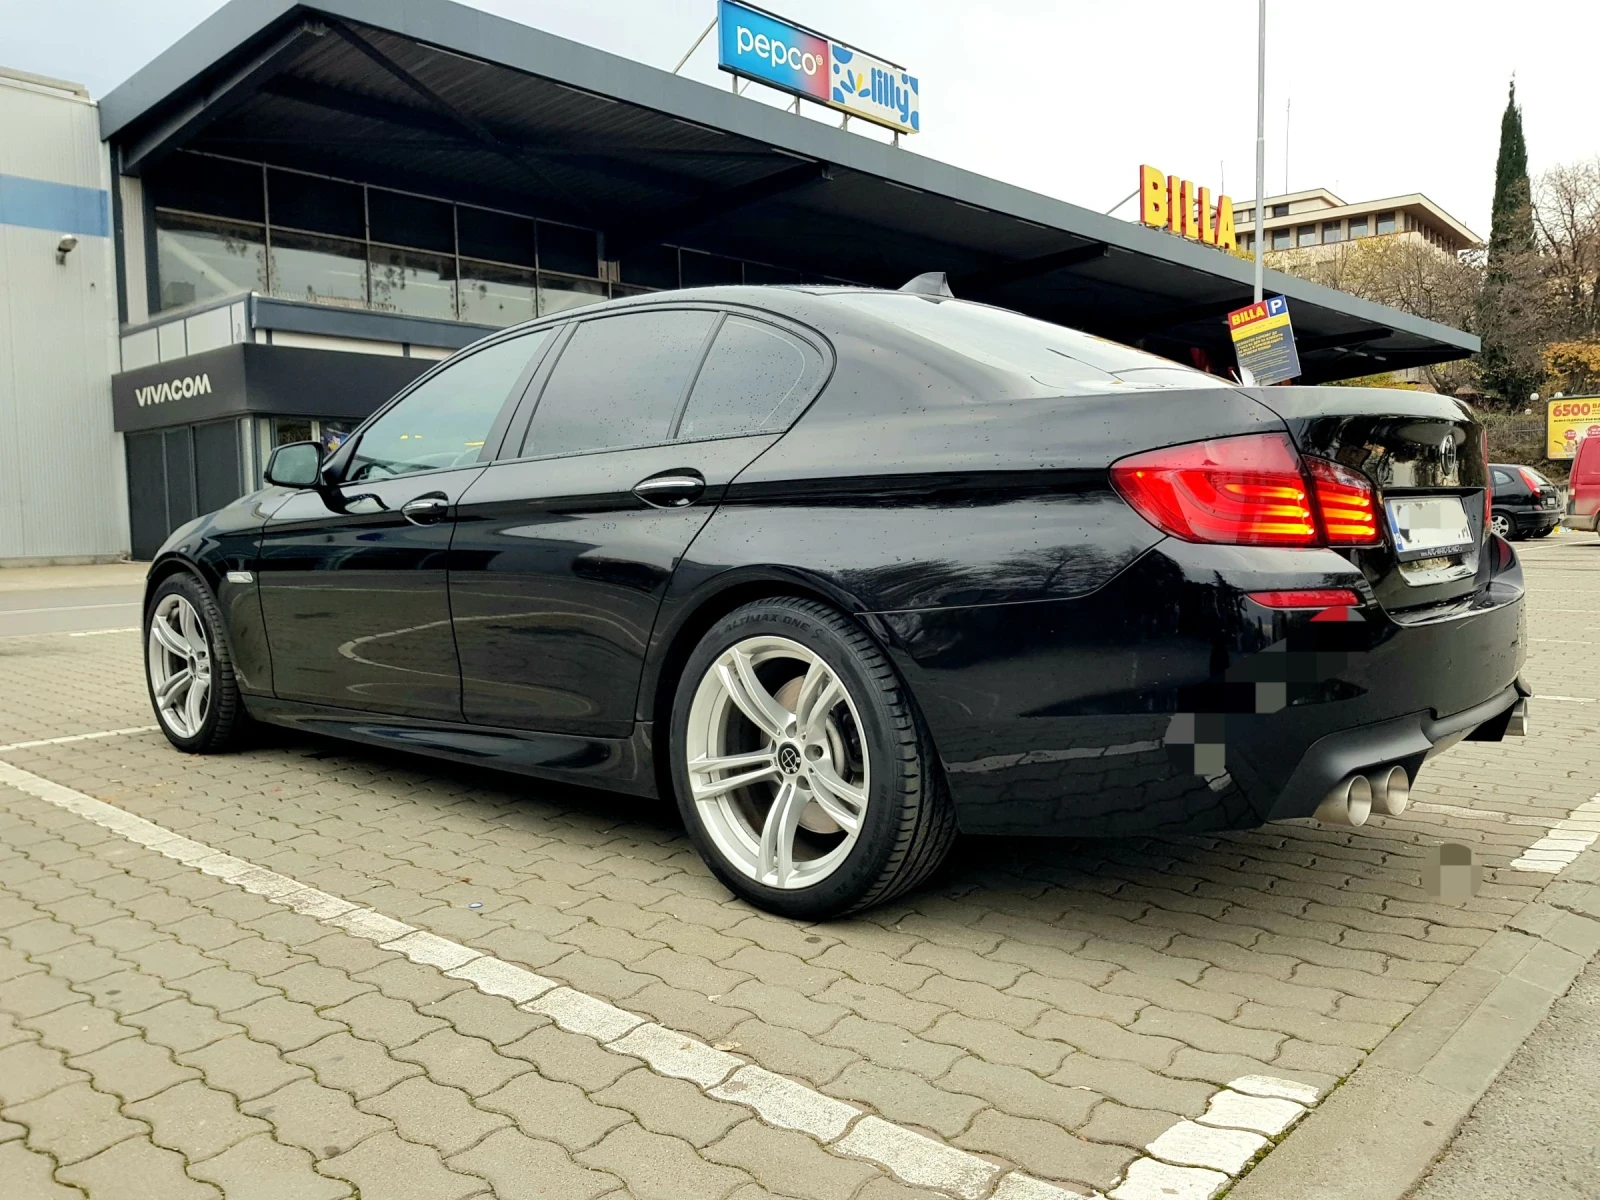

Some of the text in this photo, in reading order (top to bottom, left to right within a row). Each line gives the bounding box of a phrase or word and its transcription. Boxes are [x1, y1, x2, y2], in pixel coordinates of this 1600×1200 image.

[871, 67, 909, 123] lilly
[1140, 164, 1237, 250] BILLA
[1231, 299, 1283, 326] BILLA P
[135, 373, 212, 407] VIVACOM
[1553, 403, 1591, 417] 6500
[724, 613, 779, 632] ALTIMAX
[783, 615, 811, 632] ONE
